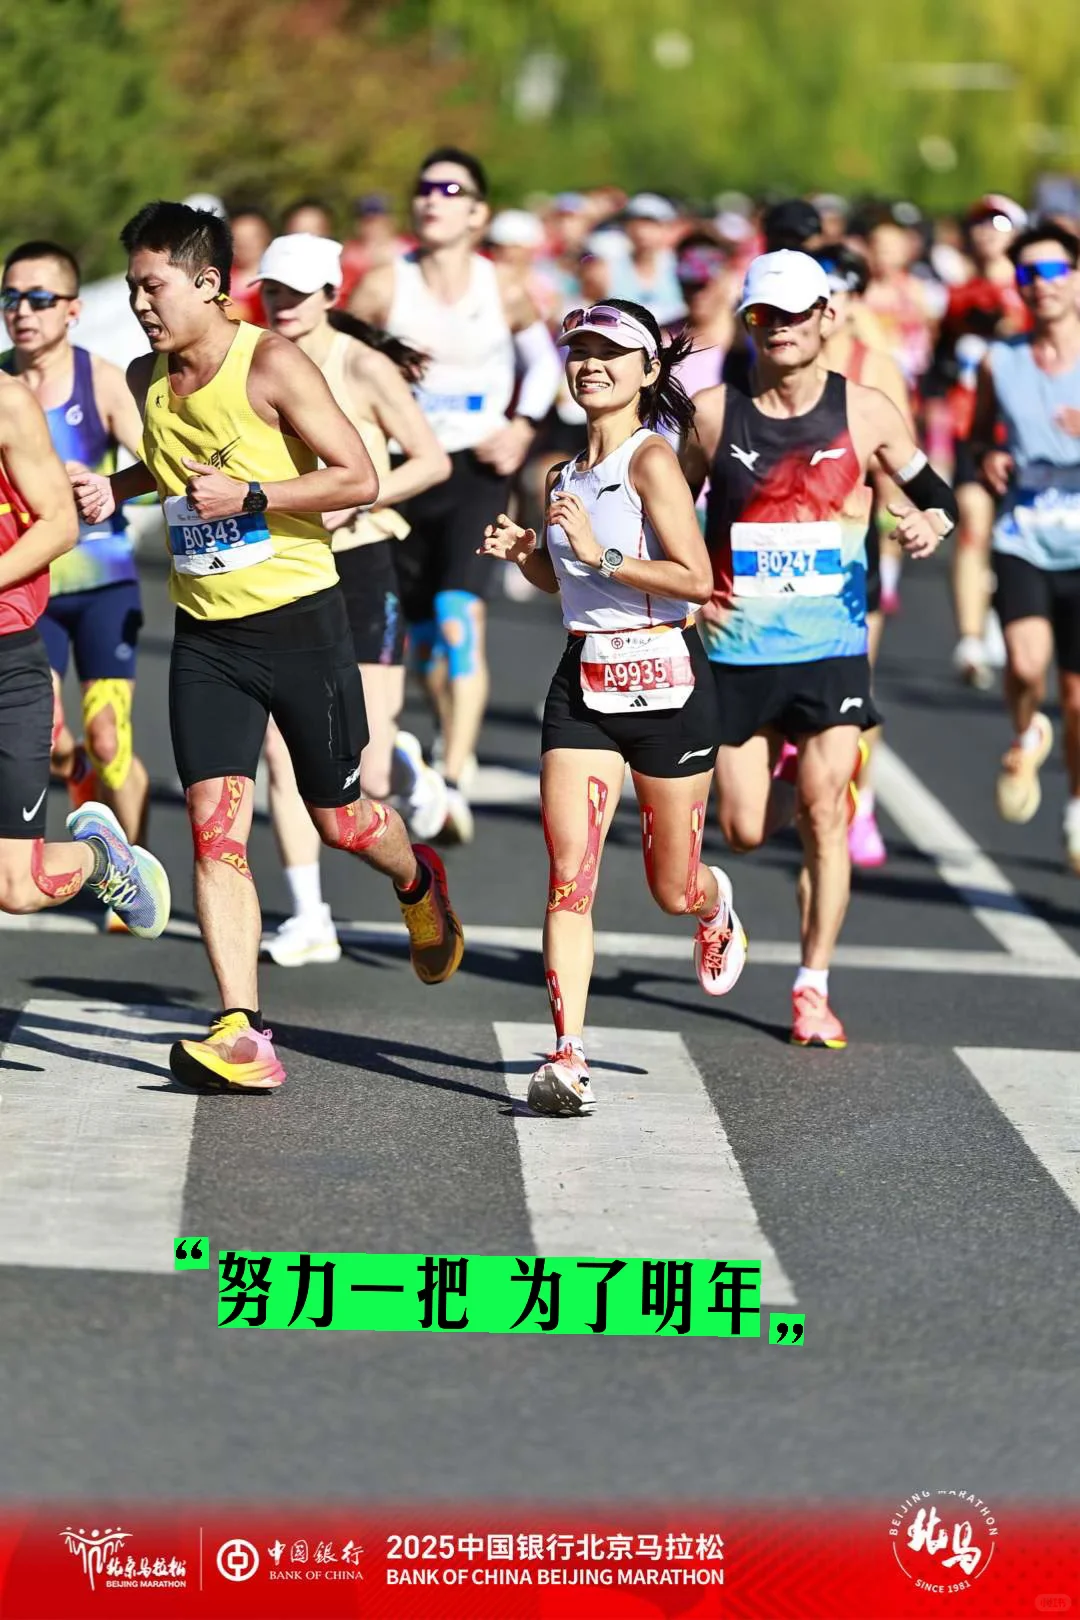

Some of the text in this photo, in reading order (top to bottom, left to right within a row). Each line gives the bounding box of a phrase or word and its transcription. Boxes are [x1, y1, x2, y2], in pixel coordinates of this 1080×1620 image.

[182, 518, 241, 549] B0343
[757, 549, 817, 573] B0247
[604, 658, 667, 687] A9935
